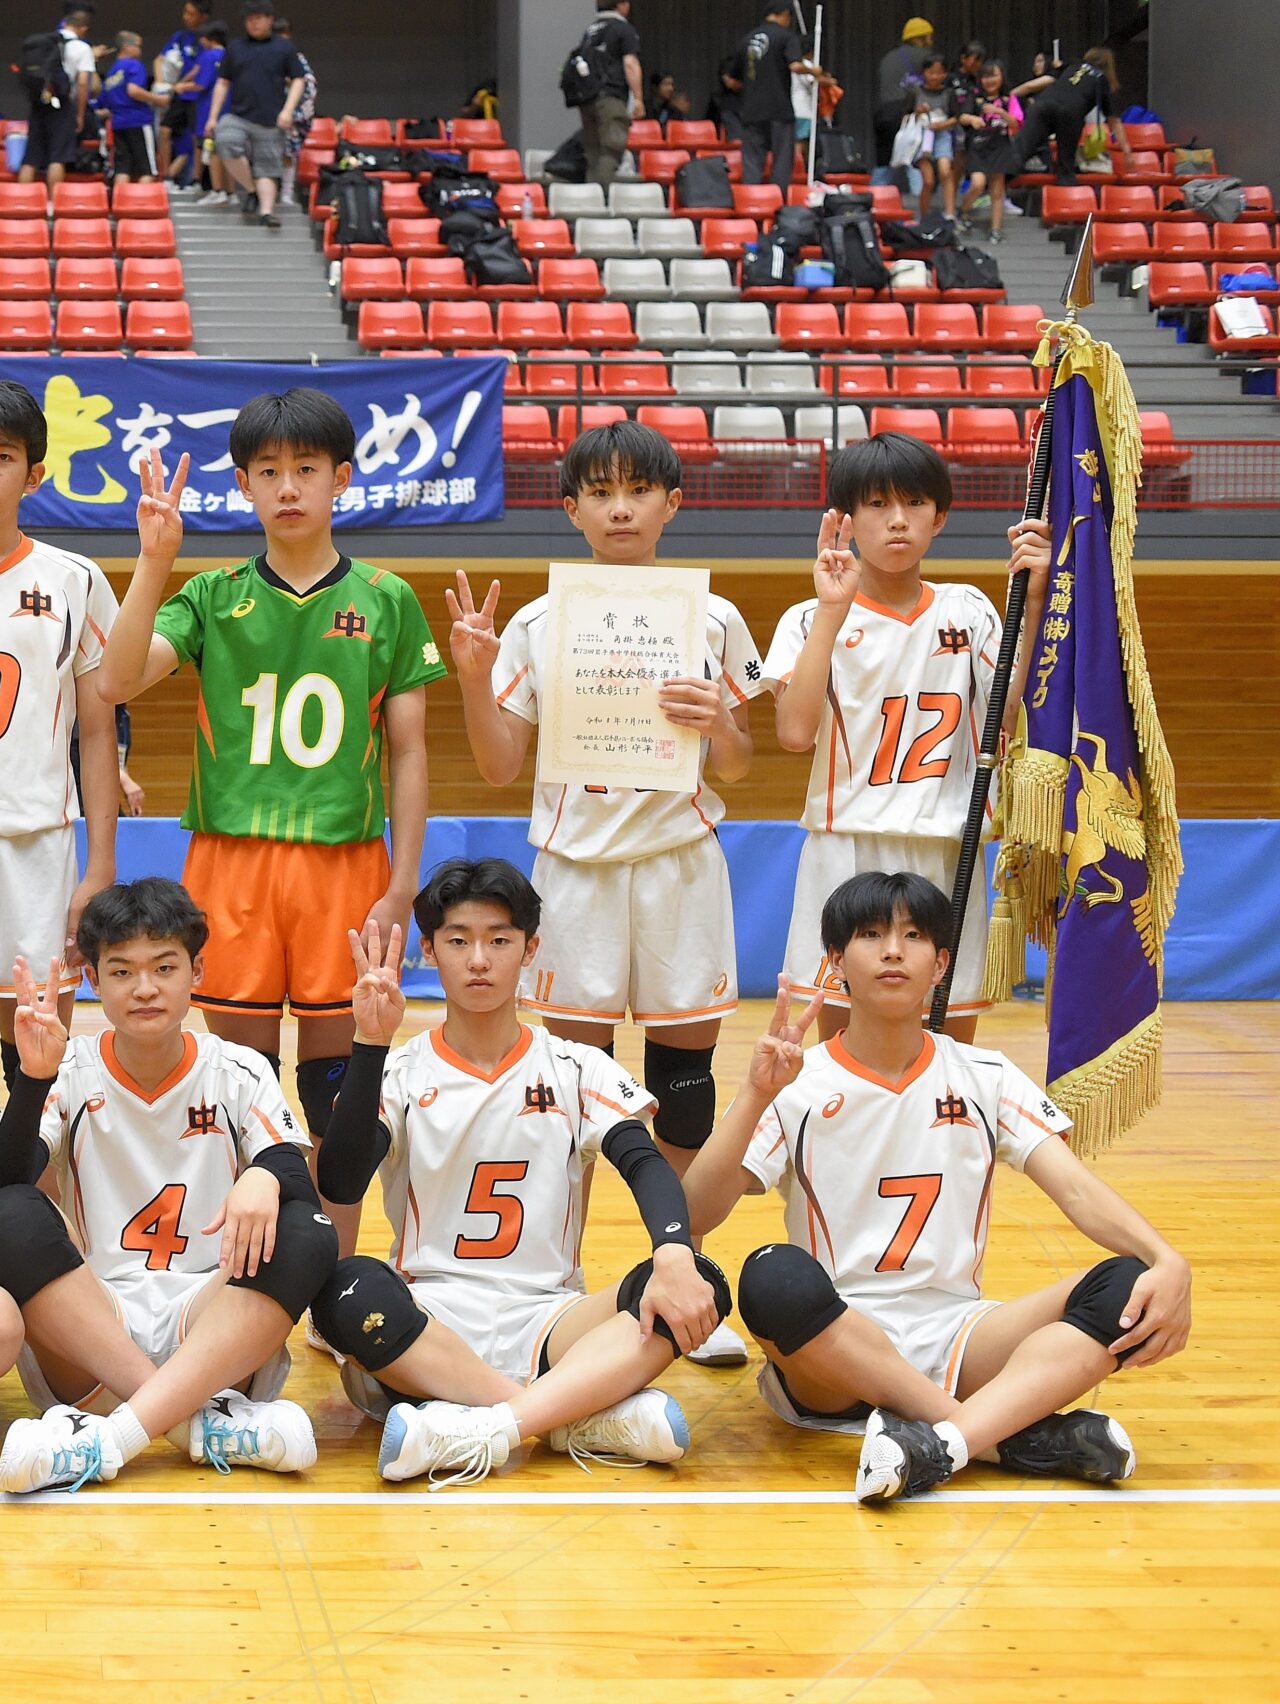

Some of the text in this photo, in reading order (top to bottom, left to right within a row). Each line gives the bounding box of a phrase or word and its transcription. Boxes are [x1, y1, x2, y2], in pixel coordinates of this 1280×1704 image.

[602, 612, 649, 630] 賞状
[575, 684, 641, 696] として表彰します
[744, 659, 761, 682] 岩
[241, 672, 345, 769] 10
[868, 691, 962, 787] 12
[535, 968, 555, 1001] 11
[813, 955, 843, 991] 12
[120, 1183, 189, 1271] 4
[454, 1160, 530, 1260] 5
[874, 1173, 943, 1272] 7
